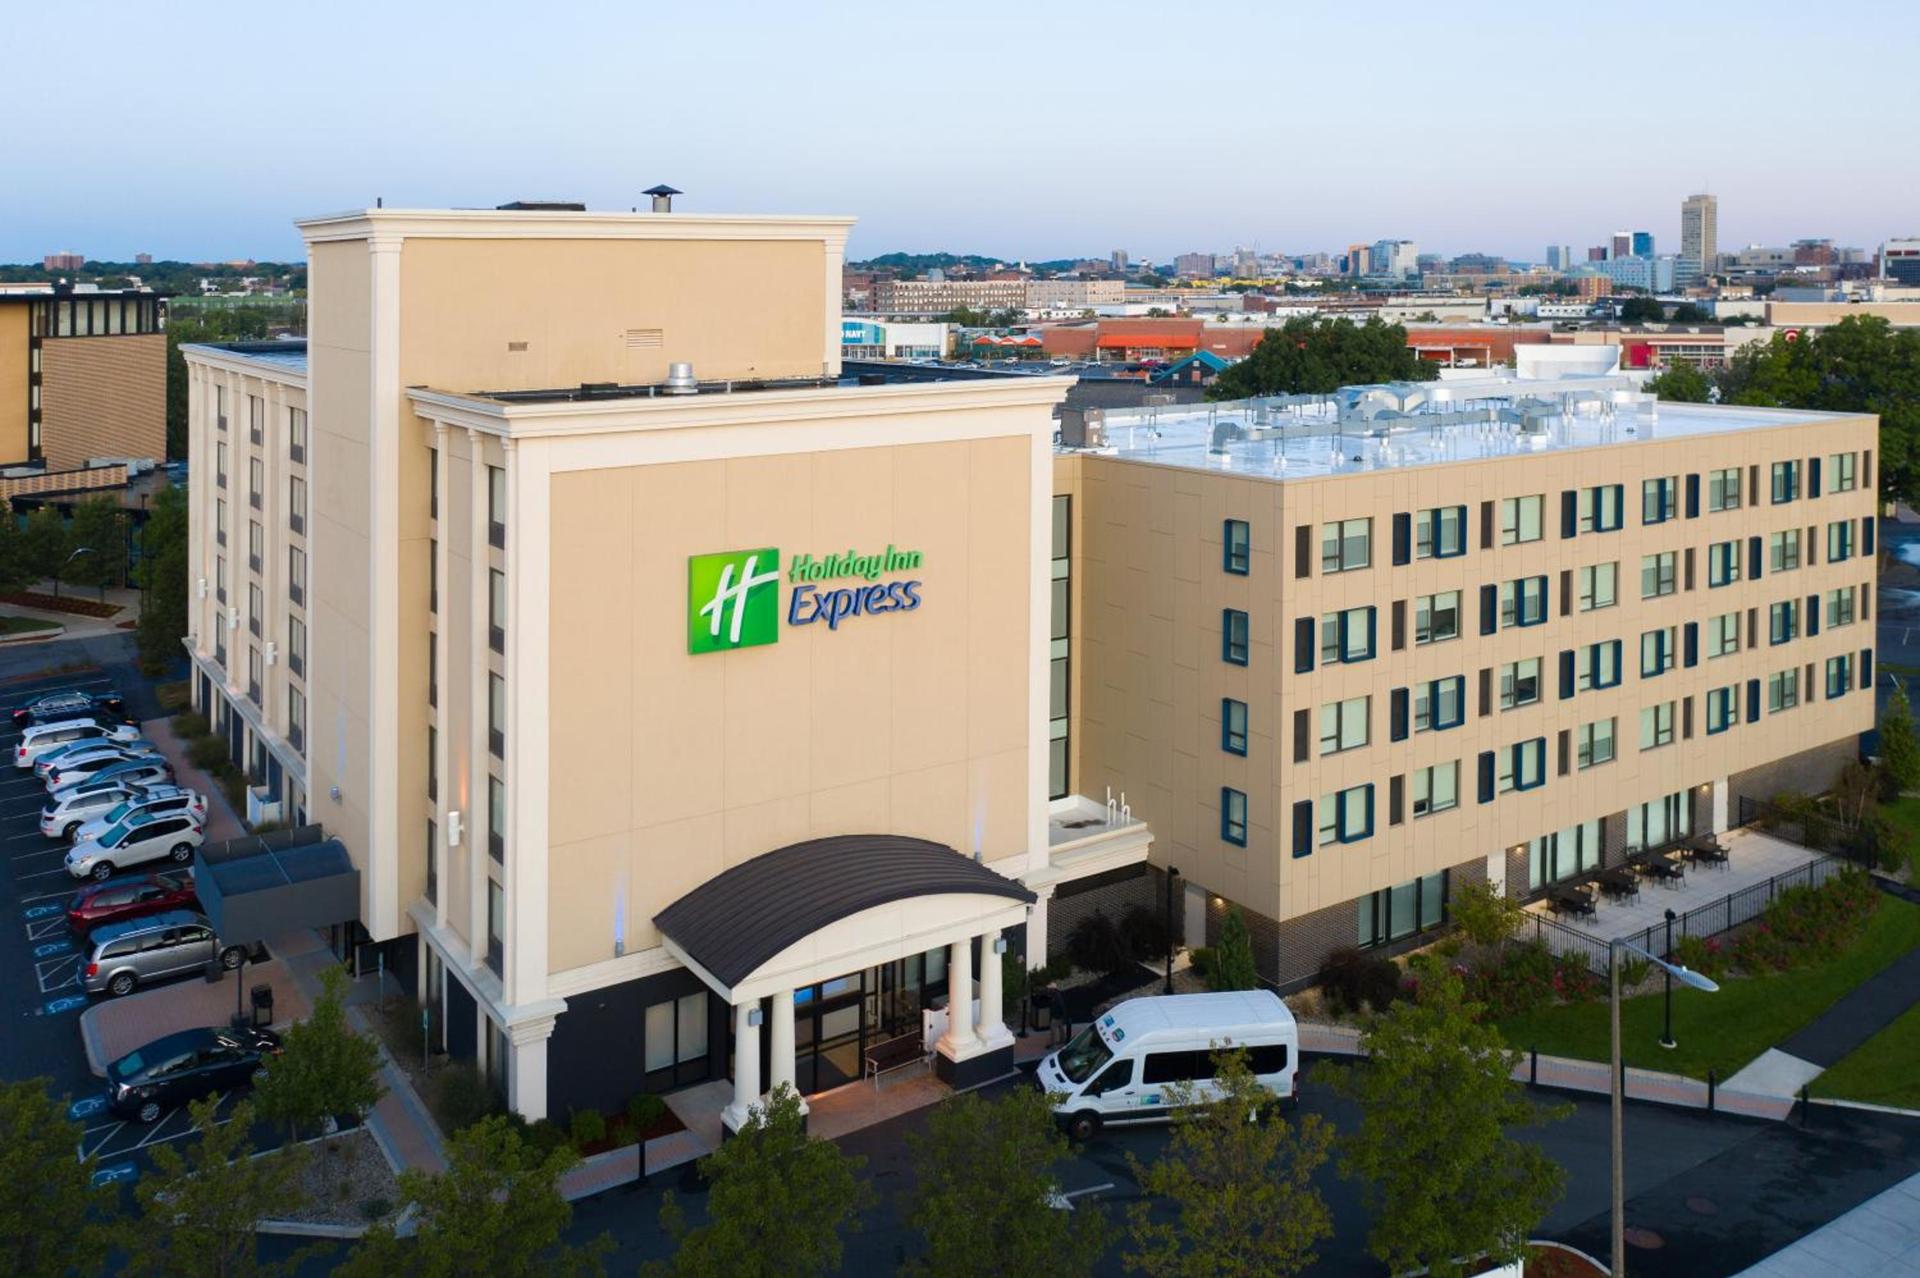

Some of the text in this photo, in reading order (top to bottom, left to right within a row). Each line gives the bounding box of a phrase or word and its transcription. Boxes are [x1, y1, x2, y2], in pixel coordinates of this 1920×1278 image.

[788, 544, 924, 583] Holiday Inn
[788, 580, 922, 631] Express
